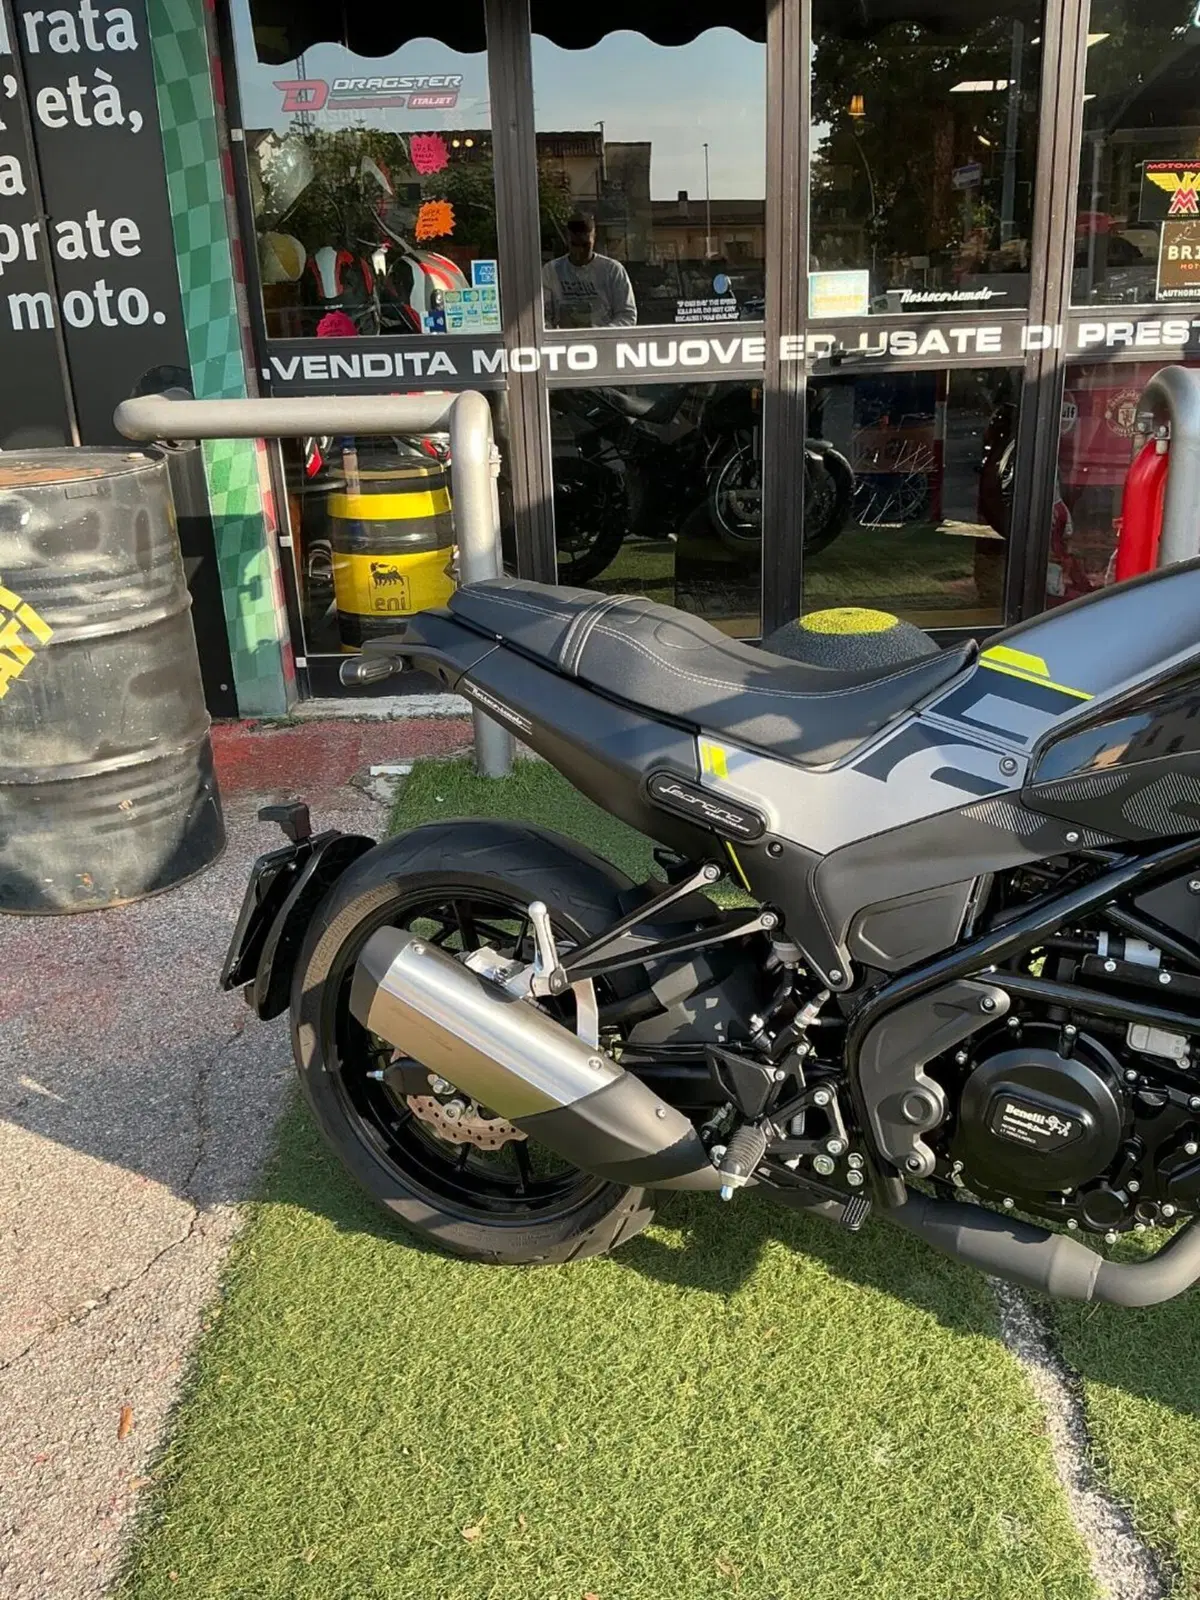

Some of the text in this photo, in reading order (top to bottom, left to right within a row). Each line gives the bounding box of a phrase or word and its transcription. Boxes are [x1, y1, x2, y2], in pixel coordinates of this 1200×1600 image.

[333, 75, 463, 91] DRAGSTER
[412, 96, 454, 106] ITALJET
[7, 279, 166, 330] moto.
[473, 344, 598, 374] MOTO
[616, 338, 765, 368] NUOVE
[780, 334, 836, 360] ED
[859, 326, 1002, 357] USATE
[1021, 324, 1063, 350] DI
[375, 591, 405, 611] eni
[1005, 1103, 1046, 1125] Benelli
